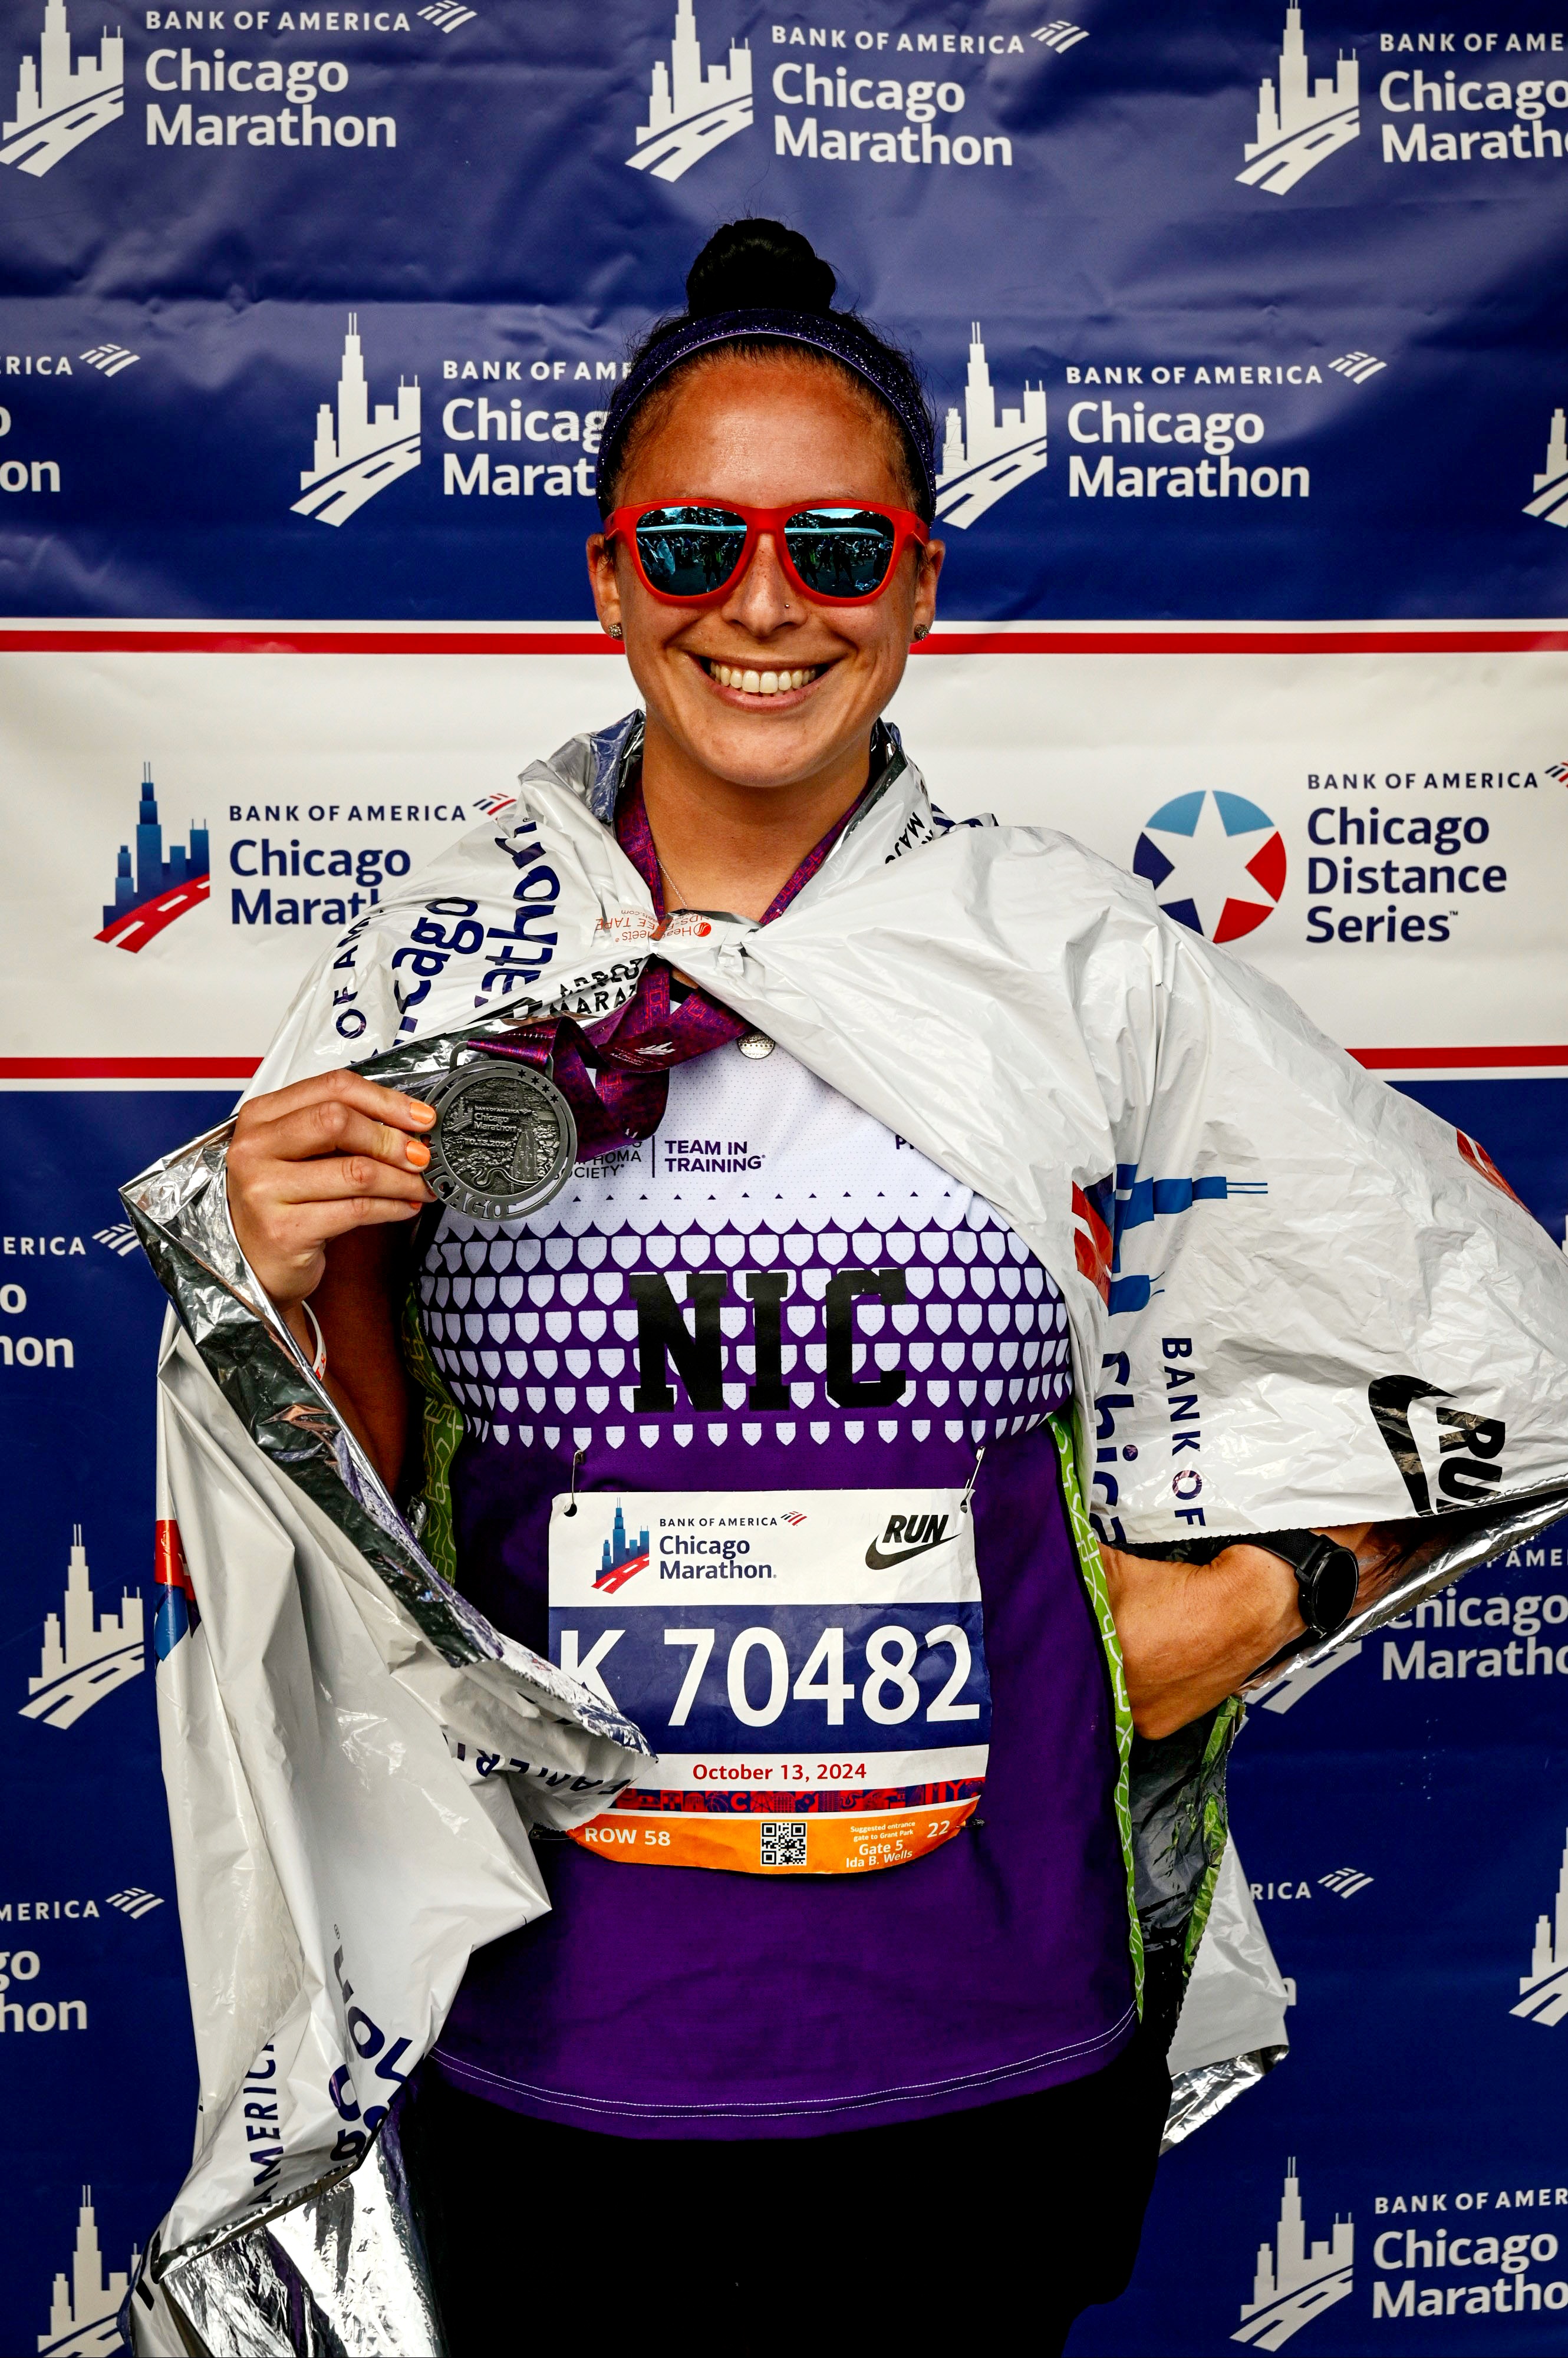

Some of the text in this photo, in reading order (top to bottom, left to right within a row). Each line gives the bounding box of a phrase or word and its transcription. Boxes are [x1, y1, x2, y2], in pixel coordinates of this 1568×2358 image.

[146, 11, 410, 31] BANK OF AMERICA
[772, 25, 1025, 55] BANK OF AMERICA
[1380, 33, 1455, 52] BANK
[1464, 33, 1498, 52] OF
[146, 48, 349, 103] Chicago
[772, 62, 965, 123] Chicago
[1380, 70, 1568, 120] Chicago
[147, 104, 396, 147] Marathon
[775, 116, 1013, 166] Marathon
[1381, 120, 1568, 163] Marath
[443, 360, 522, 380] BANK
[530, 361, 566, 380] OF
[1066, 365, 1323, 384] BANK OF AMERICA
[442, 397, 611, 455] Chicag
[1068, 400, 1264, 456] Chicago
[1069, 455, 1310, 498] Marathon
[1308, 772, 1538, 789] BANK OF AMERICA
[229, 805, 466, 821] BANK OF AMERICA
[1307, 806, 1490, 855] Chicago
[229, 838, 411, 887] Chicago
[1308, 856, 1507, 894] Distance
[473, 1121, 518, 1133] Marathon
[474, 1112, 510, 1124] Chicago
[664, 1140, 747, 1155] TEAM IN
[629, 1269, 907, 1412] NIC
[1161, 1338, 1207, 1527] BANK OF
[1435, 1407, 1506, 1514] RU
[660, 1517, 778, 1527] BANK OF AMERICA
[882, 1514, 949, 1543] RUN
[659, 1535, 750, 1560] Chicago
[561, 1624, 980, 1727] K 70482
[693, 1763, 867, 1783] October 13, 2024
[585, 1828, 671, 1846] ROW 58
[850, 1821, 915, 1834] Suggested entrance
[854, 1835, 869, 1843] gate
[879, 1831, 898, 1839] Grant
[900, 1829, 914, 1838] Park
[927, 1820, 950, 1839] 22
[846, 1850, 913, 1868] Ida B. Wells
[859, 1839, 904, 1856] Gate 5
[1375, 2194, 1447, 2214] BANK
[1455, 2192, 1489, 2211] OF
[1373, 2228, 1559, 2274] Chicago
